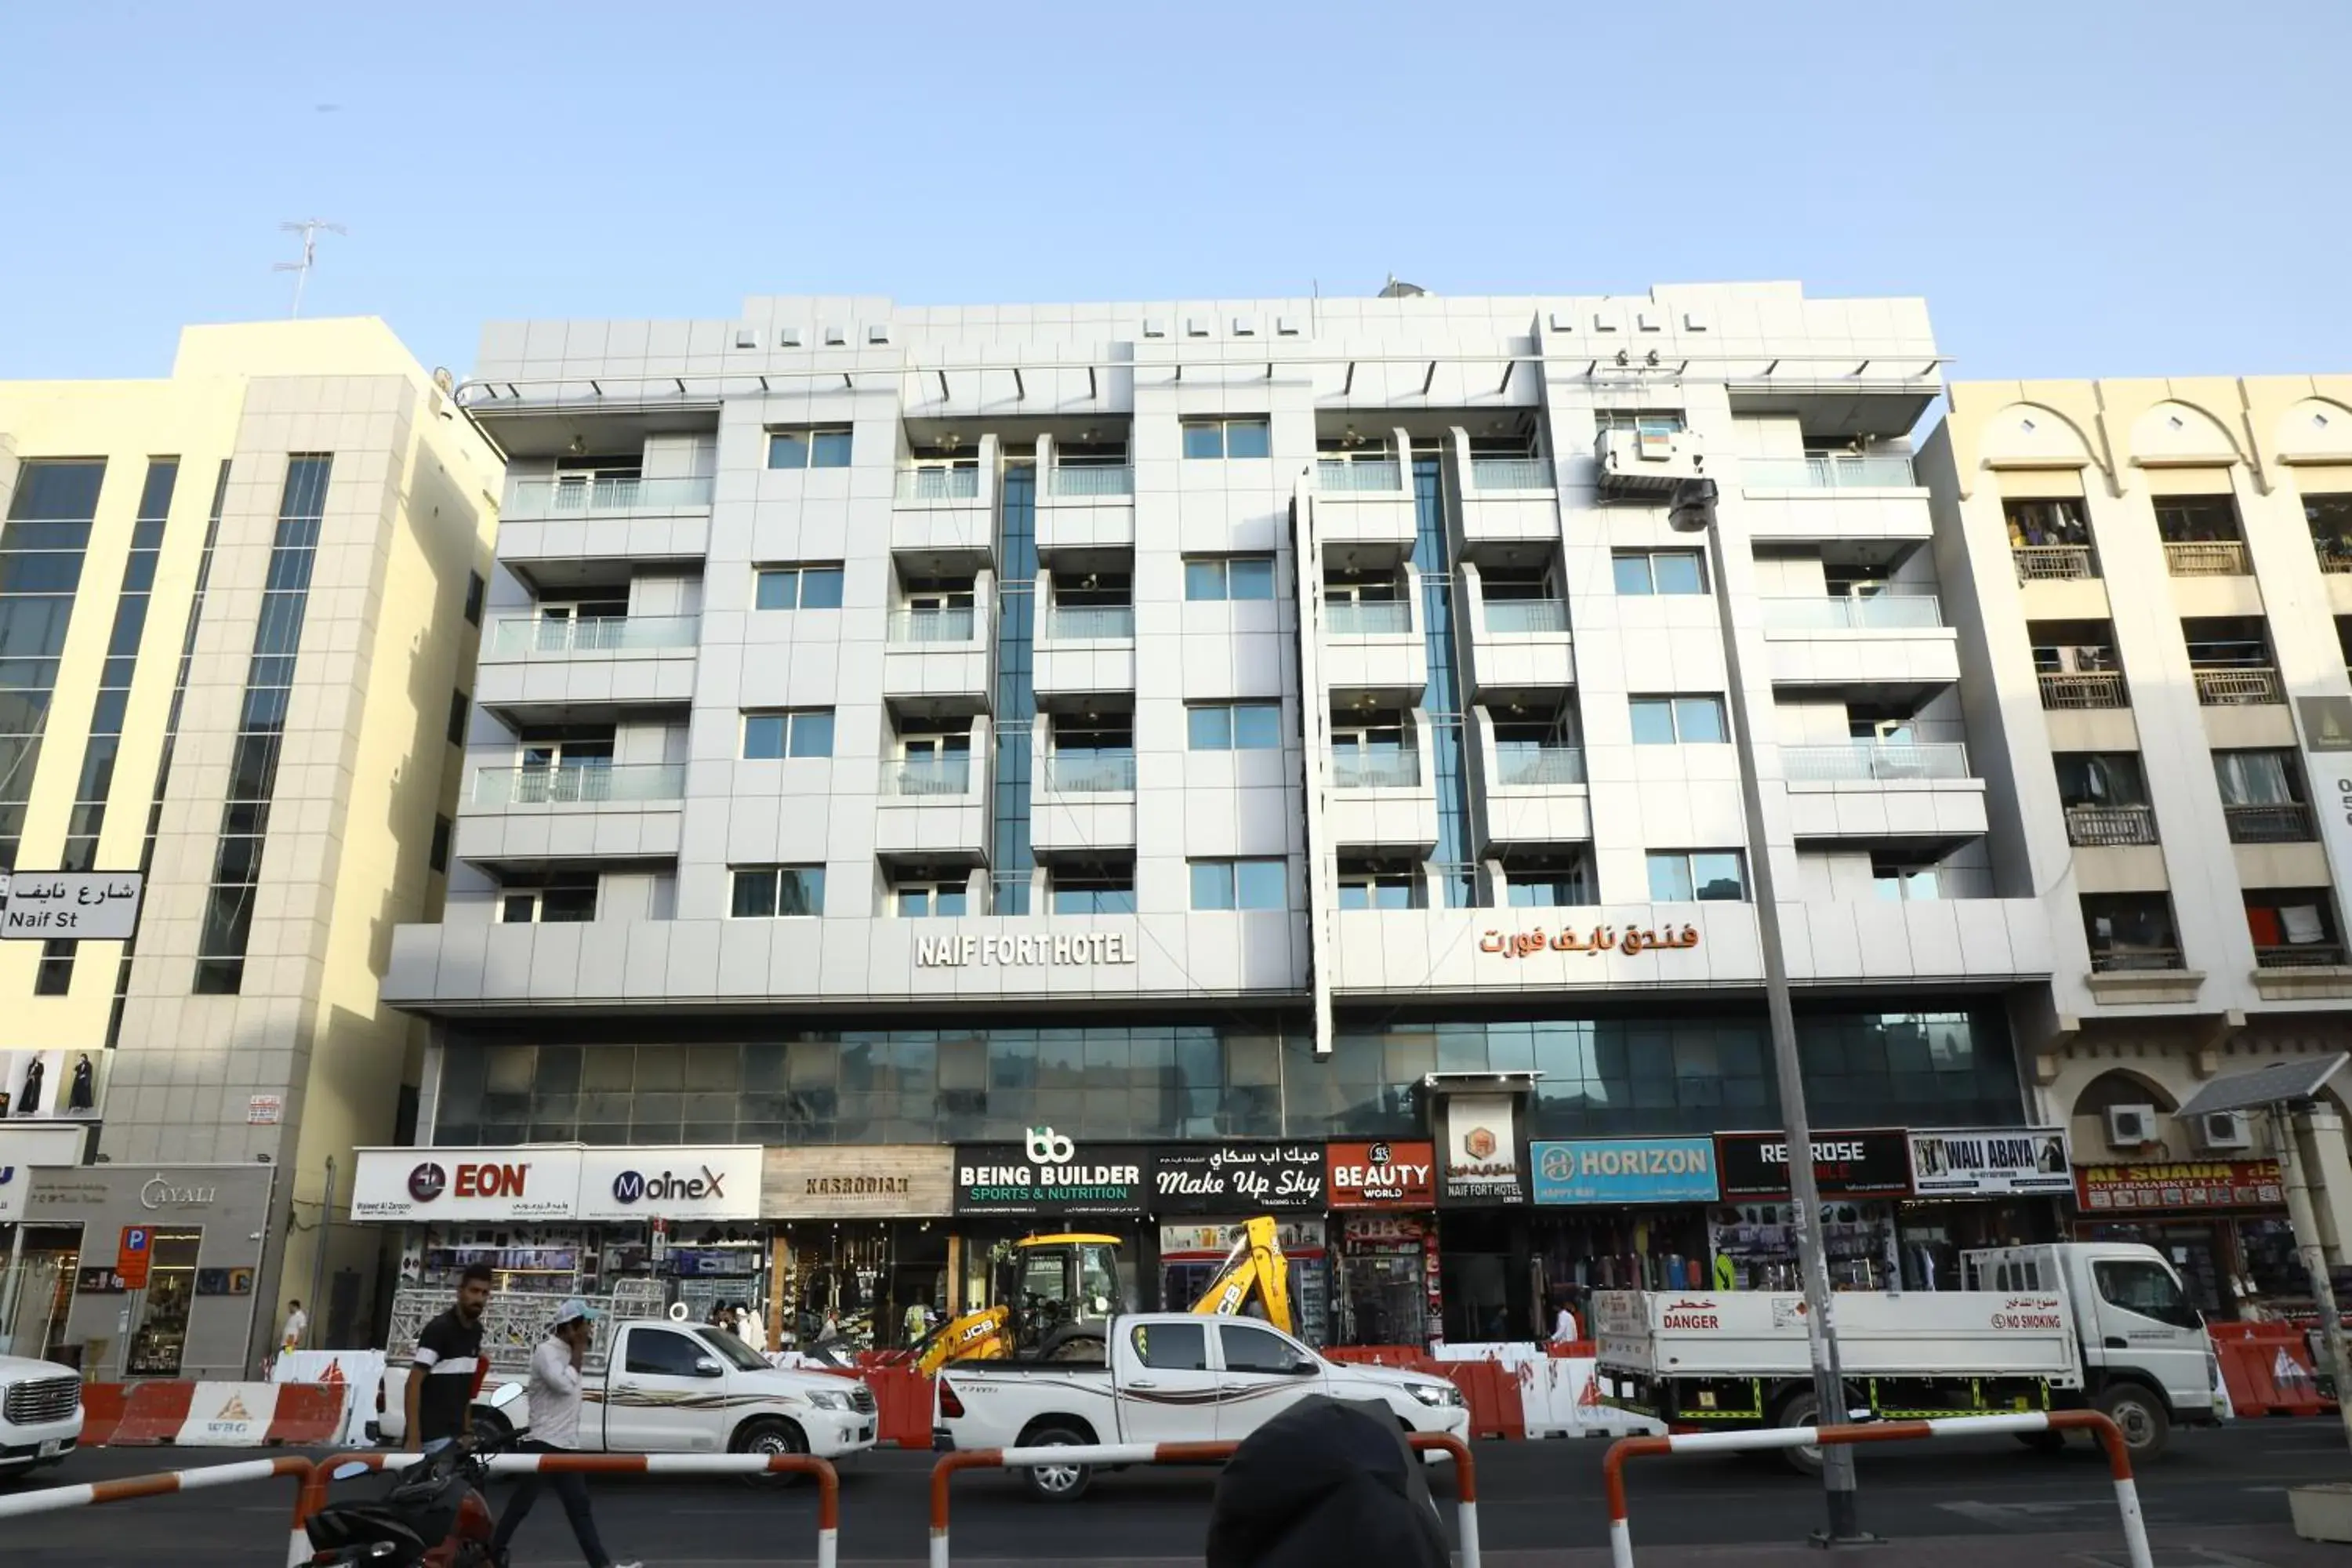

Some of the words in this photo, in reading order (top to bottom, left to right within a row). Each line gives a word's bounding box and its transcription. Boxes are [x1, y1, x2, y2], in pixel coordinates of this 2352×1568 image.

[15, 881, 66, 904] نايف
[78, 881, 134, 905] شارع
[9, 912, 52, 927] Naif
[56, 912, 78, 927] St
[916, 934, 977, 967] NAIF
[981, 933, 1050, 966] FORT
[1052, 932, 1136, 965] HOTEL
[1479, 926, 1547, 958] فورت
[1550, 924, 1617, 956] نايف
[1621, 923, 1699, 956] فندق
[1210, 1148, 1256, 1171] سكاي
[1283, 1147, 1320, 1164] ميك
[1581, 1149, 1708, 1174] HORIZON
[1760, 1142, 1866, 1163] REROSE
[1945, 1140, 1984, 1169] WALI
[1987, 1139, 2035, 1168] ABAYA
[454, 1163, 527, 1197] EON
[960, 1166, 1031, 1186] BEING
[1040, 1166, 1140, 1185] BUILDER
[1156, 1171, 1225, 1194] Make
[1232, 1171, 1270, 1200] Up
[1275, 1170, 1321, 1198] Sky
[1334, 1164, 1429, 1186] BEAUTY
[2087, 1167, 2122, 1181] AL
[2088, 1179, 2194, 1190] SUPERMARKET
[971, 1188, 1029, 1200] SPORTS
[1033, 1188, 1044, 1200] &
[1048, 1186, 1127, 1200] NUTRITION
[1363, 1189, 1403, 1198] WORLD
[1448, 1185, 1468, 1196] NAIF
[1470, 1184, 1493, 1196] FORT
[1494, 1183, 1523, 1195] HOTEL
[1217, 1283, 1242, 1315] CB
[1666, 1298, 1716, 1312] خطر
[962, 1319, 994, 1341] JCB
[1663, 1315, 1719, 1329] DANGER
[2006, 1315, 2020, 1328] NO
[2021, 1315, 2060, 1328] SMOKING
